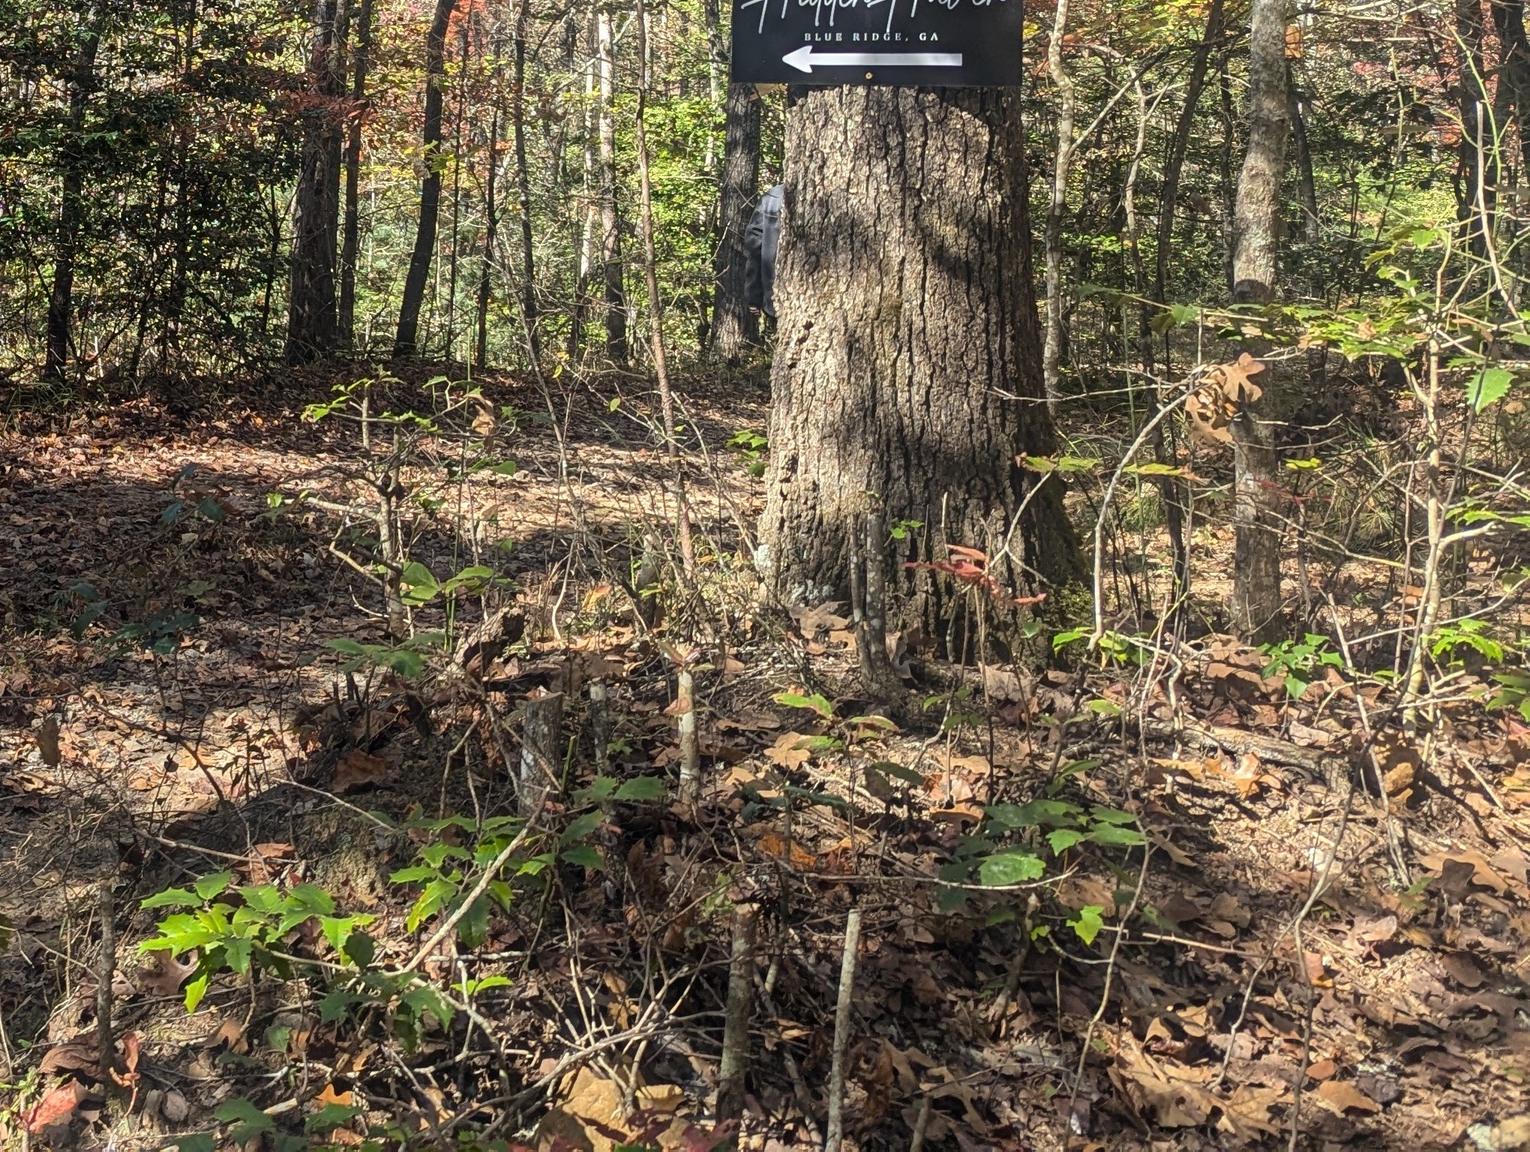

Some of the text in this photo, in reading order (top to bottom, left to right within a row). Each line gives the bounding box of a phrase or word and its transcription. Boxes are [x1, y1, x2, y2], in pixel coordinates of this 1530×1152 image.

[804, 32, 939, 42] BLUE RIDGE, GA
